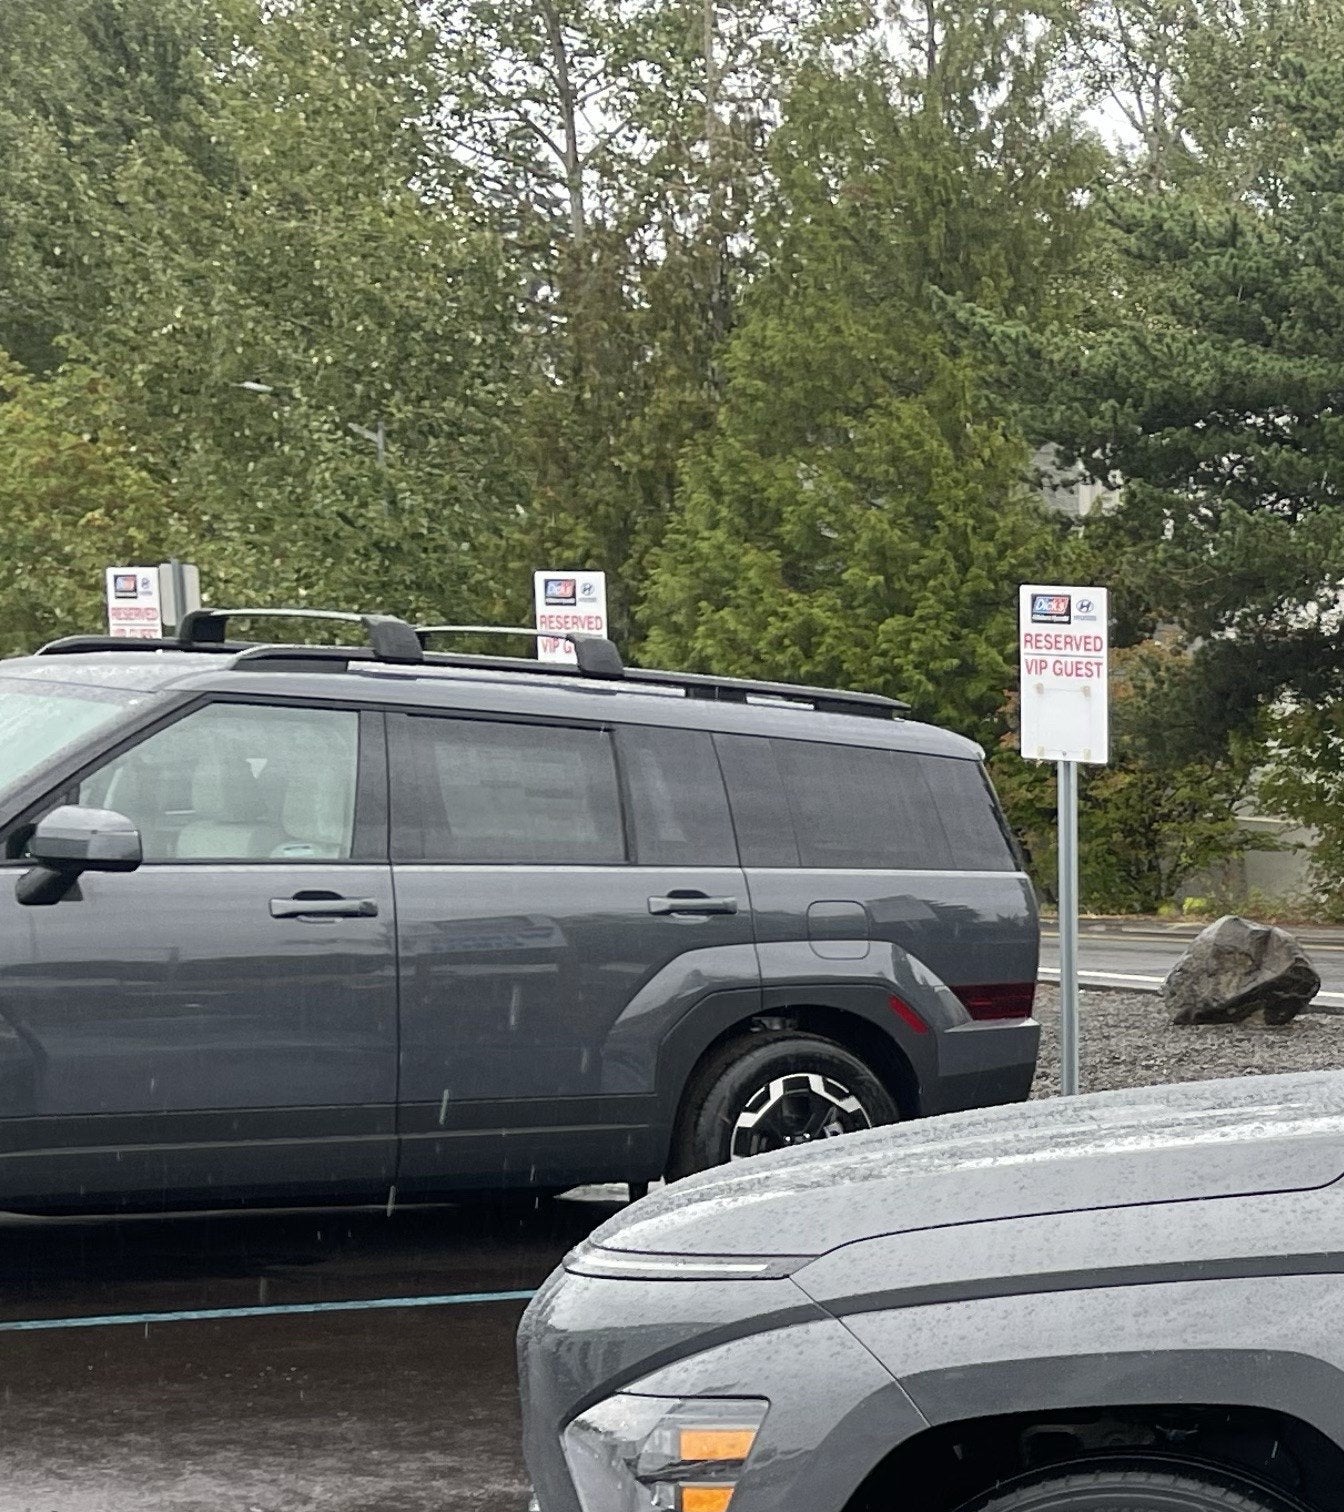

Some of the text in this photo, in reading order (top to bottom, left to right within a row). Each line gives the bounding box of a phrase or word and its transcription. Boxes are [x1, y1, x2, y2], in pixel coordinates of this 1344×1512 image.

[539, 614, 603, 631] RESERVED
[541, 637, 560, 654] VIP
[1023, 632, 1104, 652] RESERVED
[1025, 658, 1104, 679] VIP GUEST
